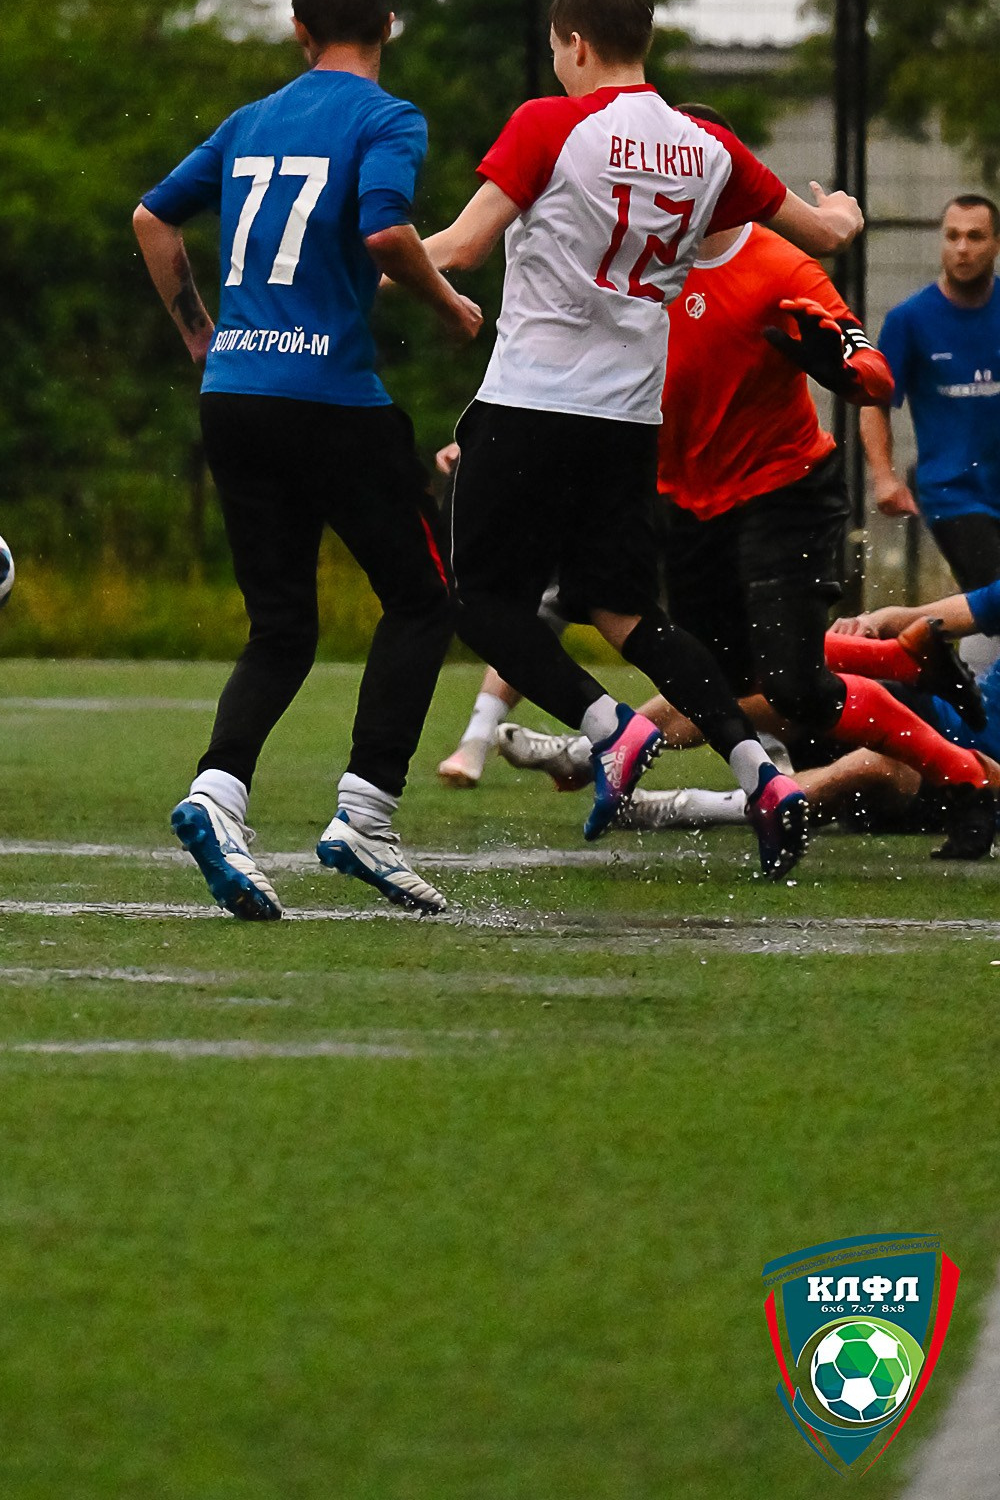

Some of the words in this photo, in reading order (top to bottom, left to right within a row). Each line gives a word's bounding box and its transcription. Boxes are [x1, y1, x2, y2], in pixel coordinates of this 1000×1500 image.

[609, 135, 704, 178] BELIKOV
[224, 156, 330, 287] 77
[593, 184, 696, 303] 12
